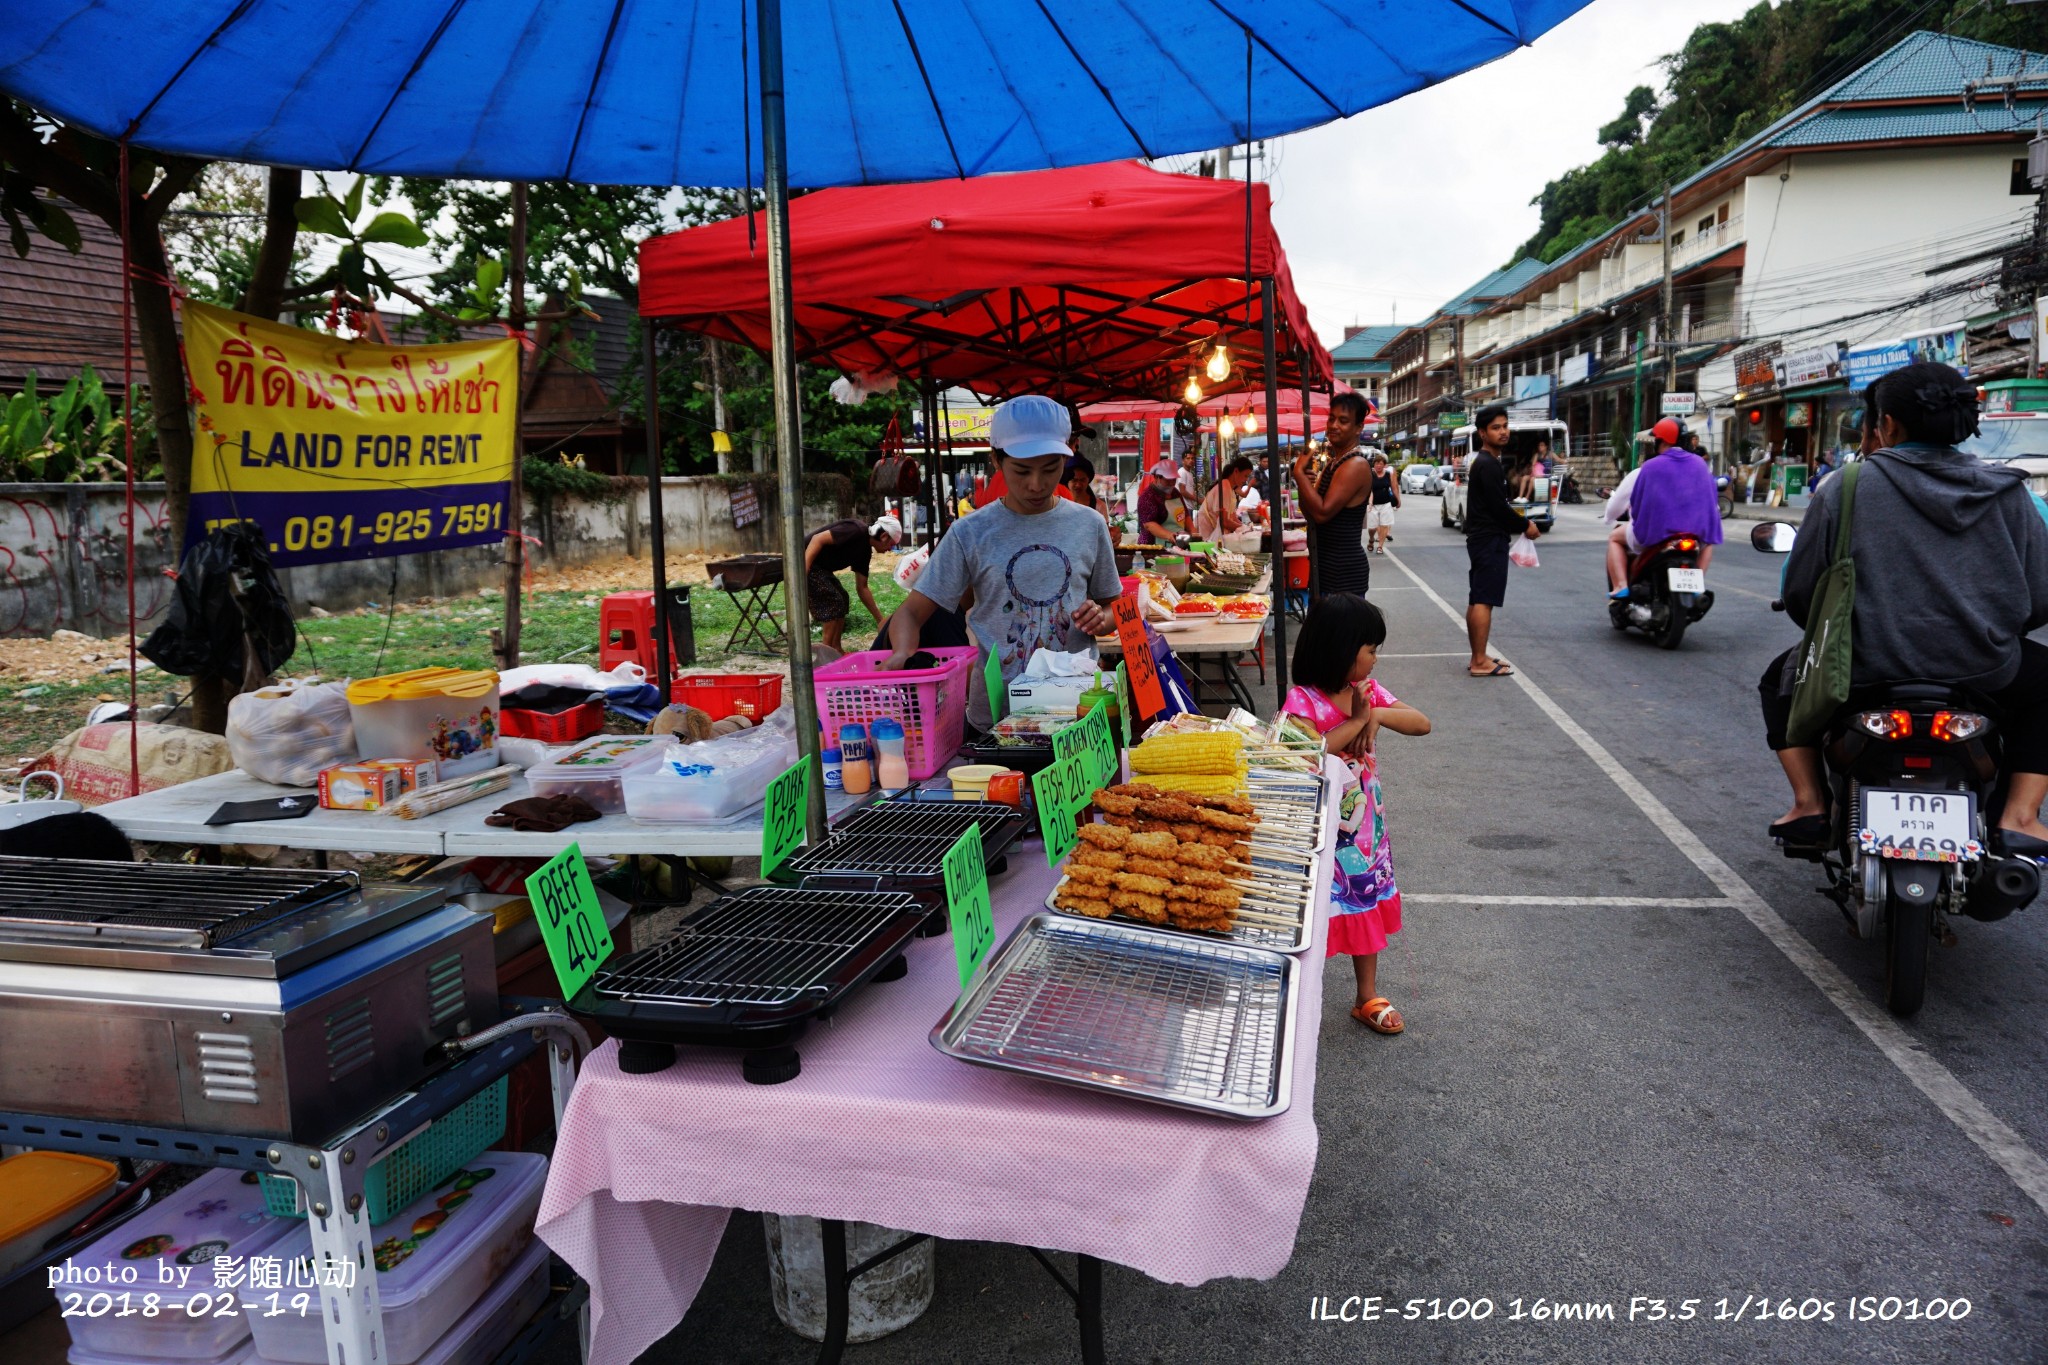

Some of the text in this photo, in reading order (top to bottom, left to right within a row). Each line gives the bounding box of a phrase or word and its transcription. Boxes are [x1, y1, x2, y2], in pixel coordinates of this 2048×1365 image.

[215, 322, 499, 415] ที่ดินว่างให้เช่า
[240, 430, 483, 469] LAND FOR RENT
[283, 508, 431, 551] 081-925
[440, 501, 503, 537] 7591
[1138, 643, 1155, 680] 30
[1057, 706, 1107, 761] CHICKEN CORN
[772, 765, 807, 824] PORK
[1040, 766, 1066, 815] FISH
[538, 854, 582, 929] BEEF
[948, 826, 985, 906] CHICKEN
